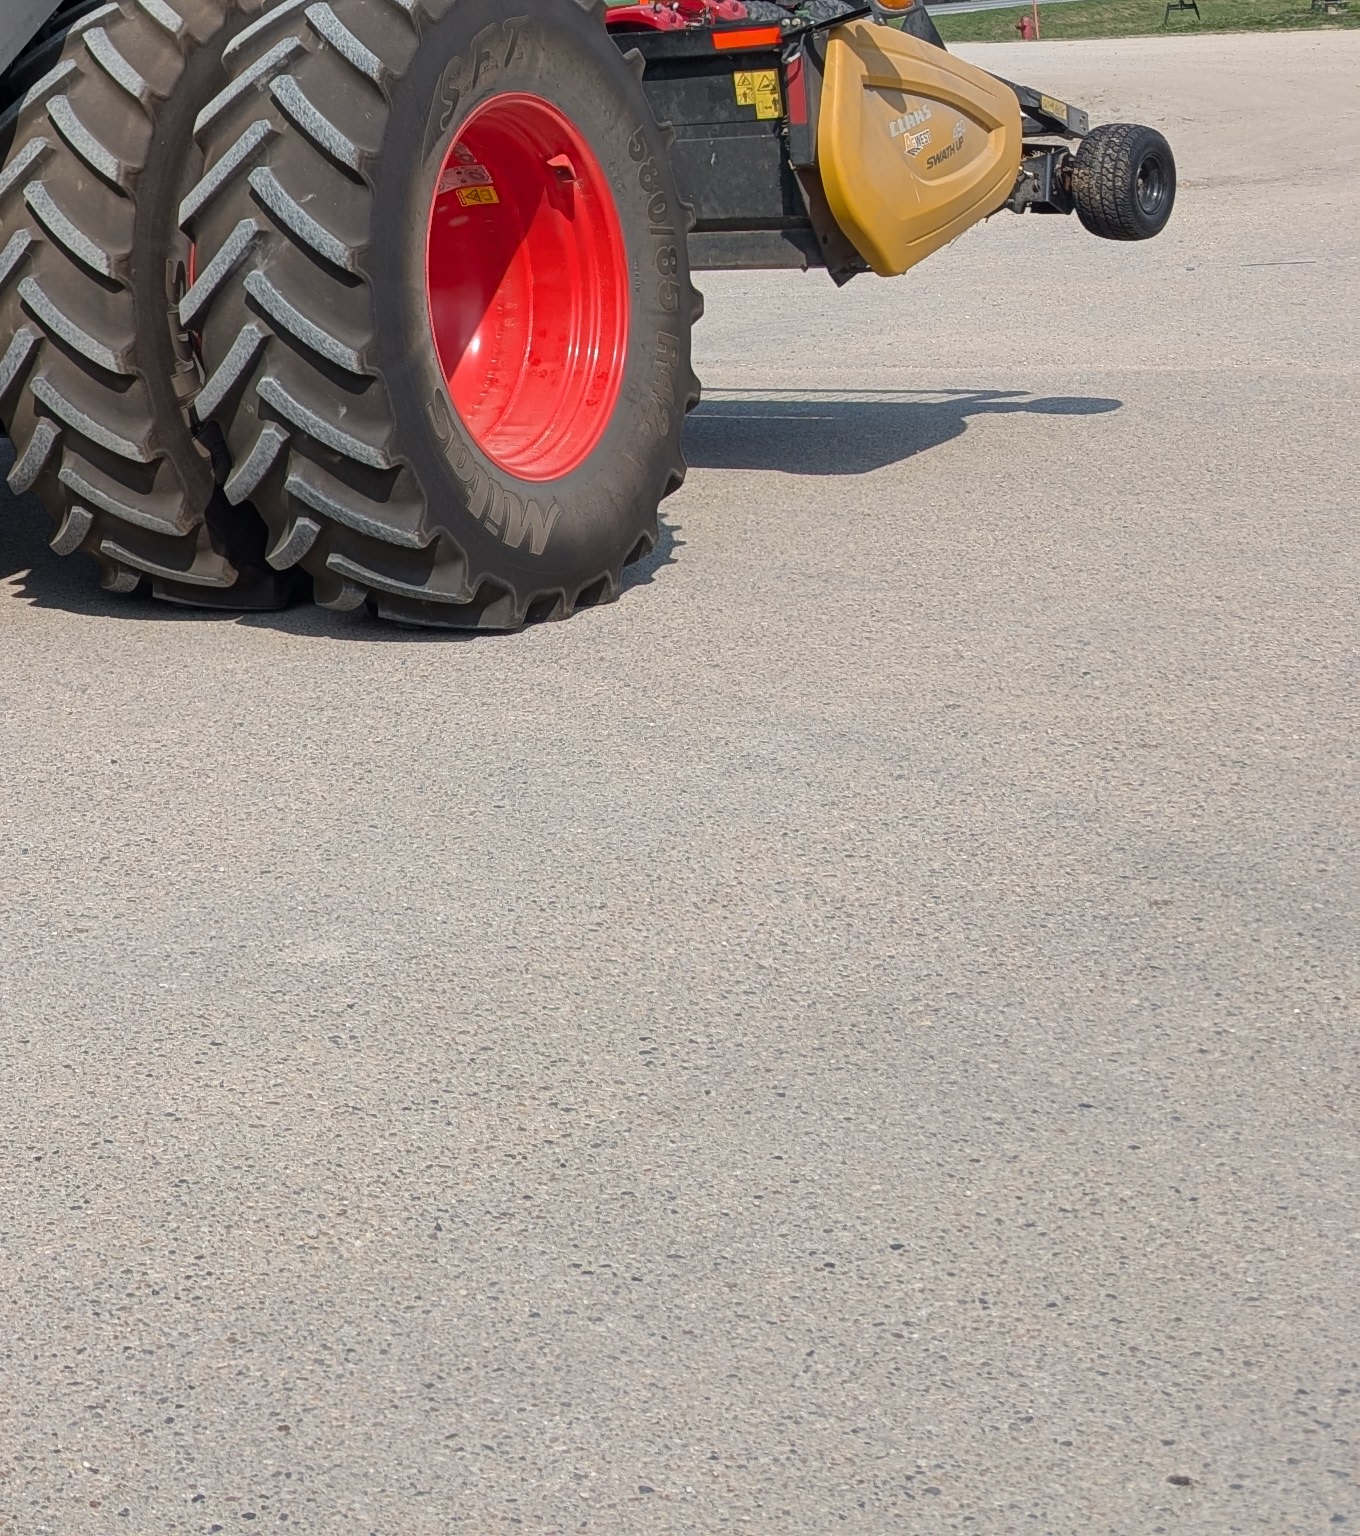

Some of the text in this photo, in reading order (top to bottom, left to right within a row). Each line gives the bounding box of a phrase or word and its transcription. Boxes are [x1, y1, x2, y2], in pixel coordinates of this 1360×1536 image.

[889, 104, 932, 138] CLAAS
[926, 135, 964, 170] SWATH UP
[426, 388, 562, 556] Mitas
